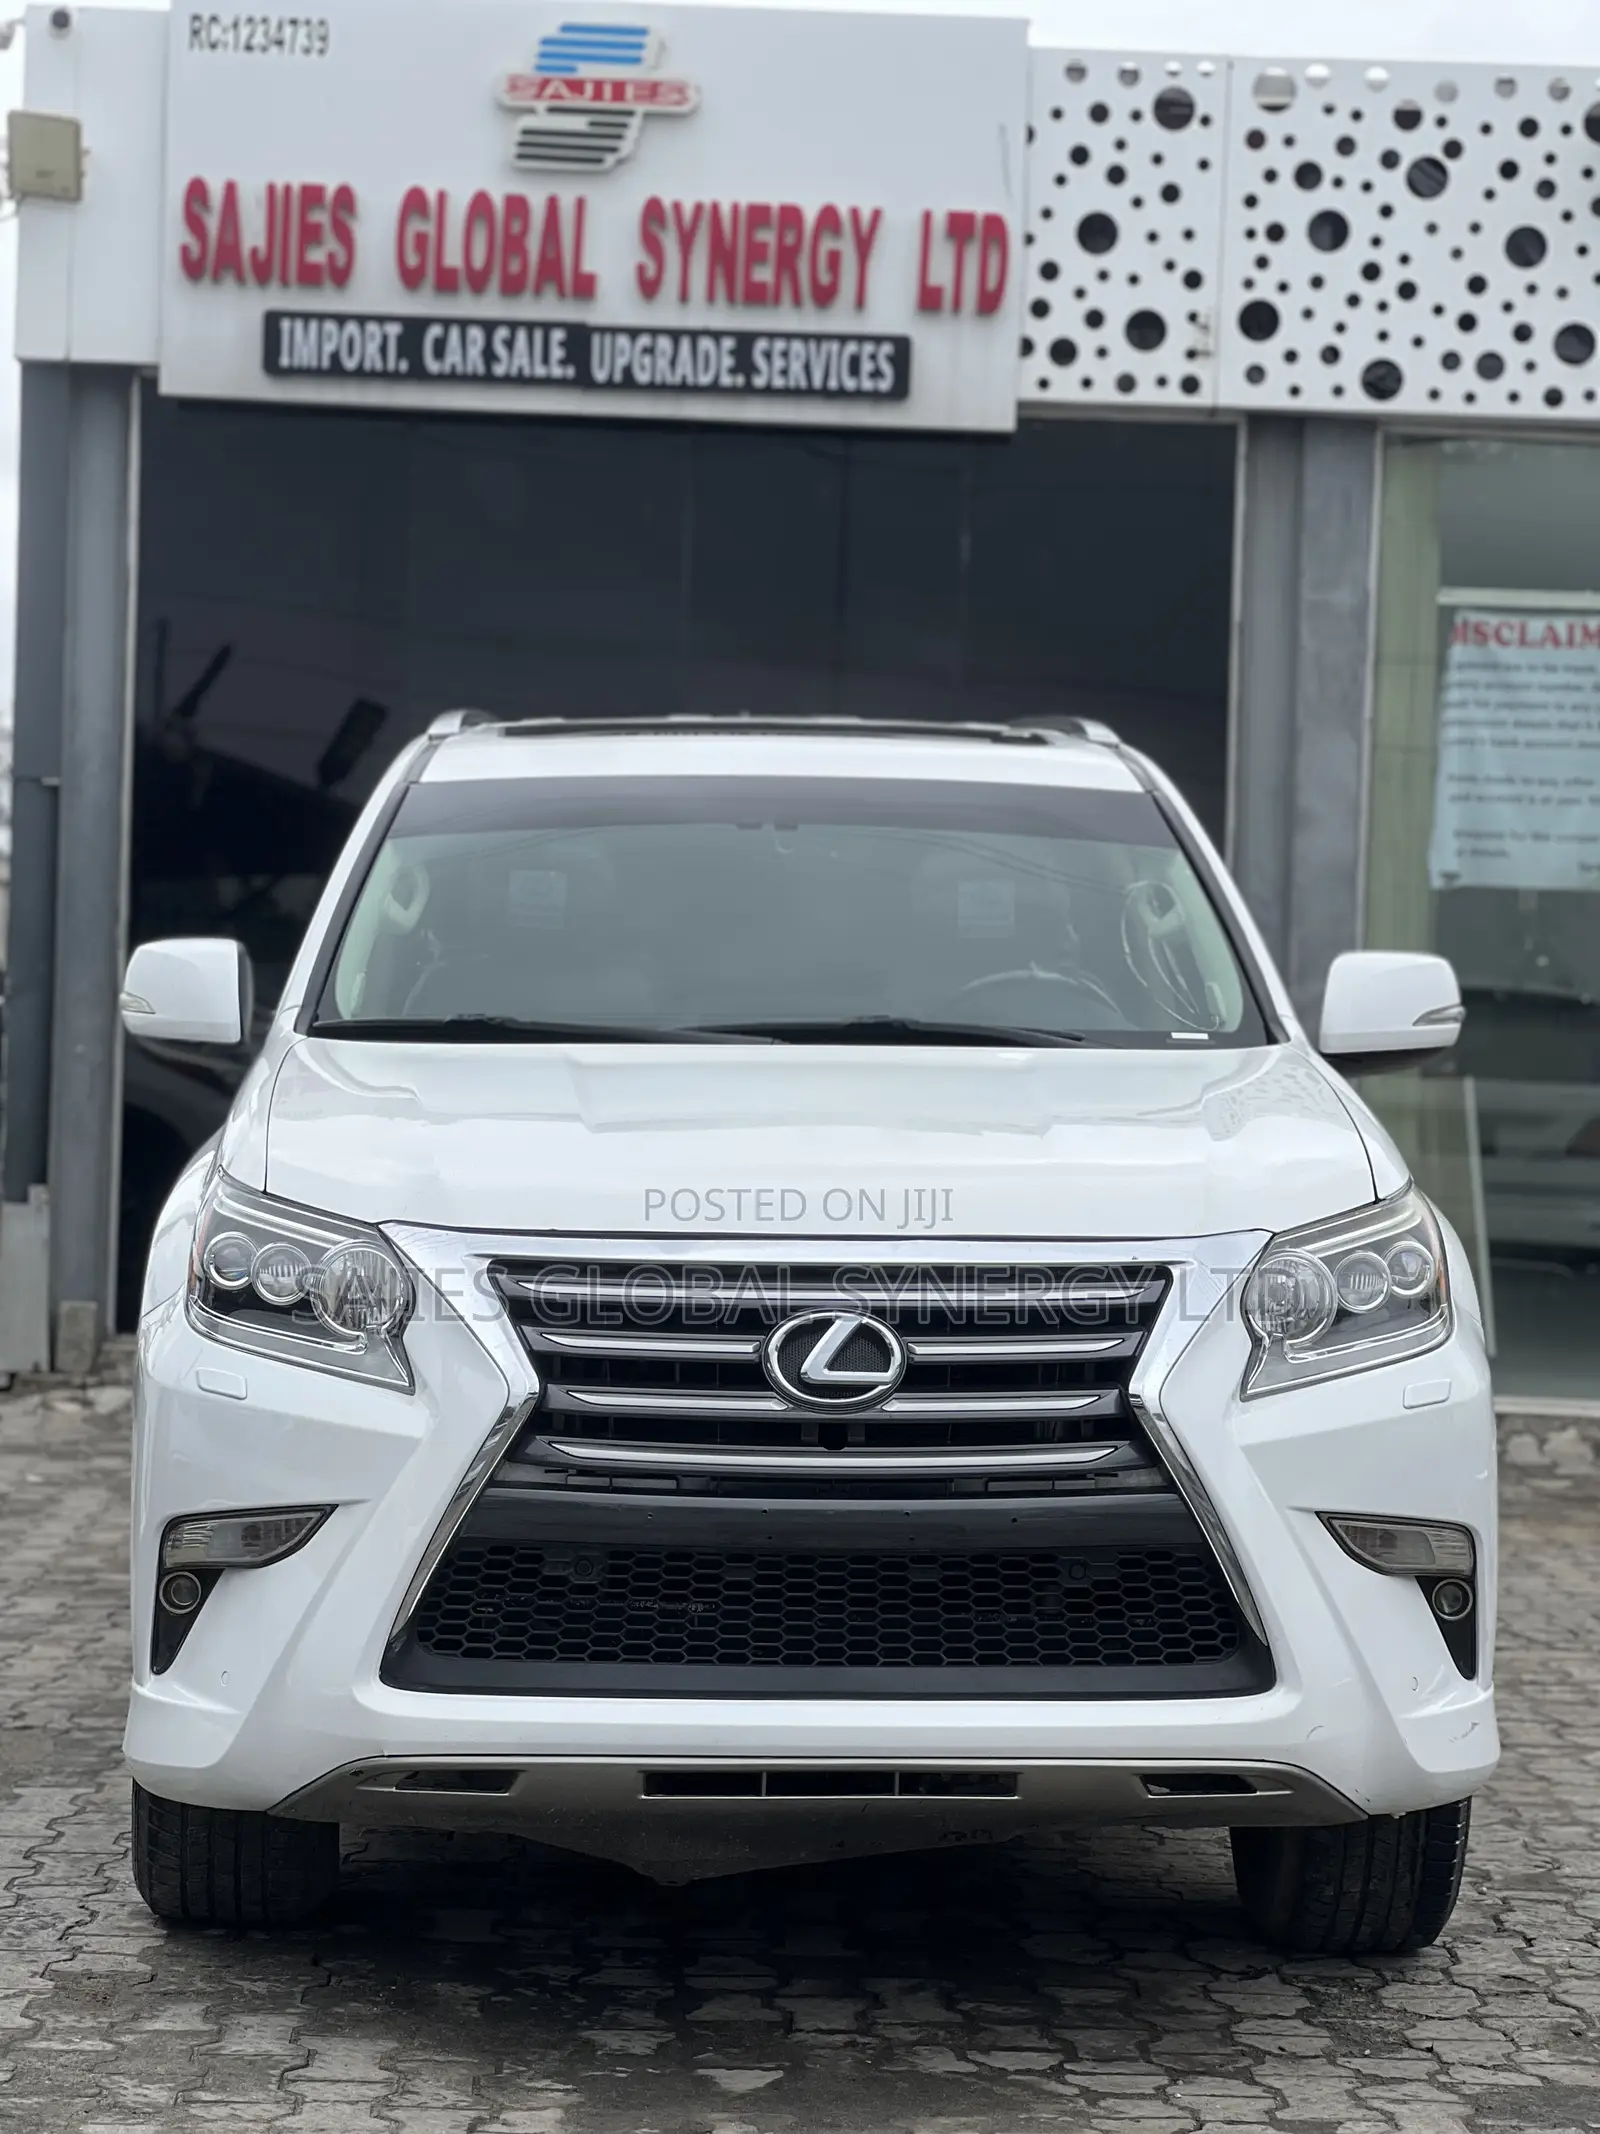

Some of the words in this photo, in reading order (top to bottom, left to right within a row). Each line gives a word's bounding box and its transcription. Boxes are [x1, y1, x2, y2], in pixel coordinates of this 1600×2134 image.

[188, 13, 329, 57] RC:1234739
[507, 75, 694, 106] SAJIES
[180, 176, 357, 287] SAJIES
[395, 185, 598, 299] GLOBAL
[635, 195, 882, 310] SYNERGY
[916, 209, 1010, 316] LTD
[278, 317, 409, 373] IMPORT.
[422, 322, 486, 376] CAR
[490, 325, 576, 380] SALE.
[590, 331, 746, 388] UPGRADE.
[750, 336, 896, 393] SERVICES
